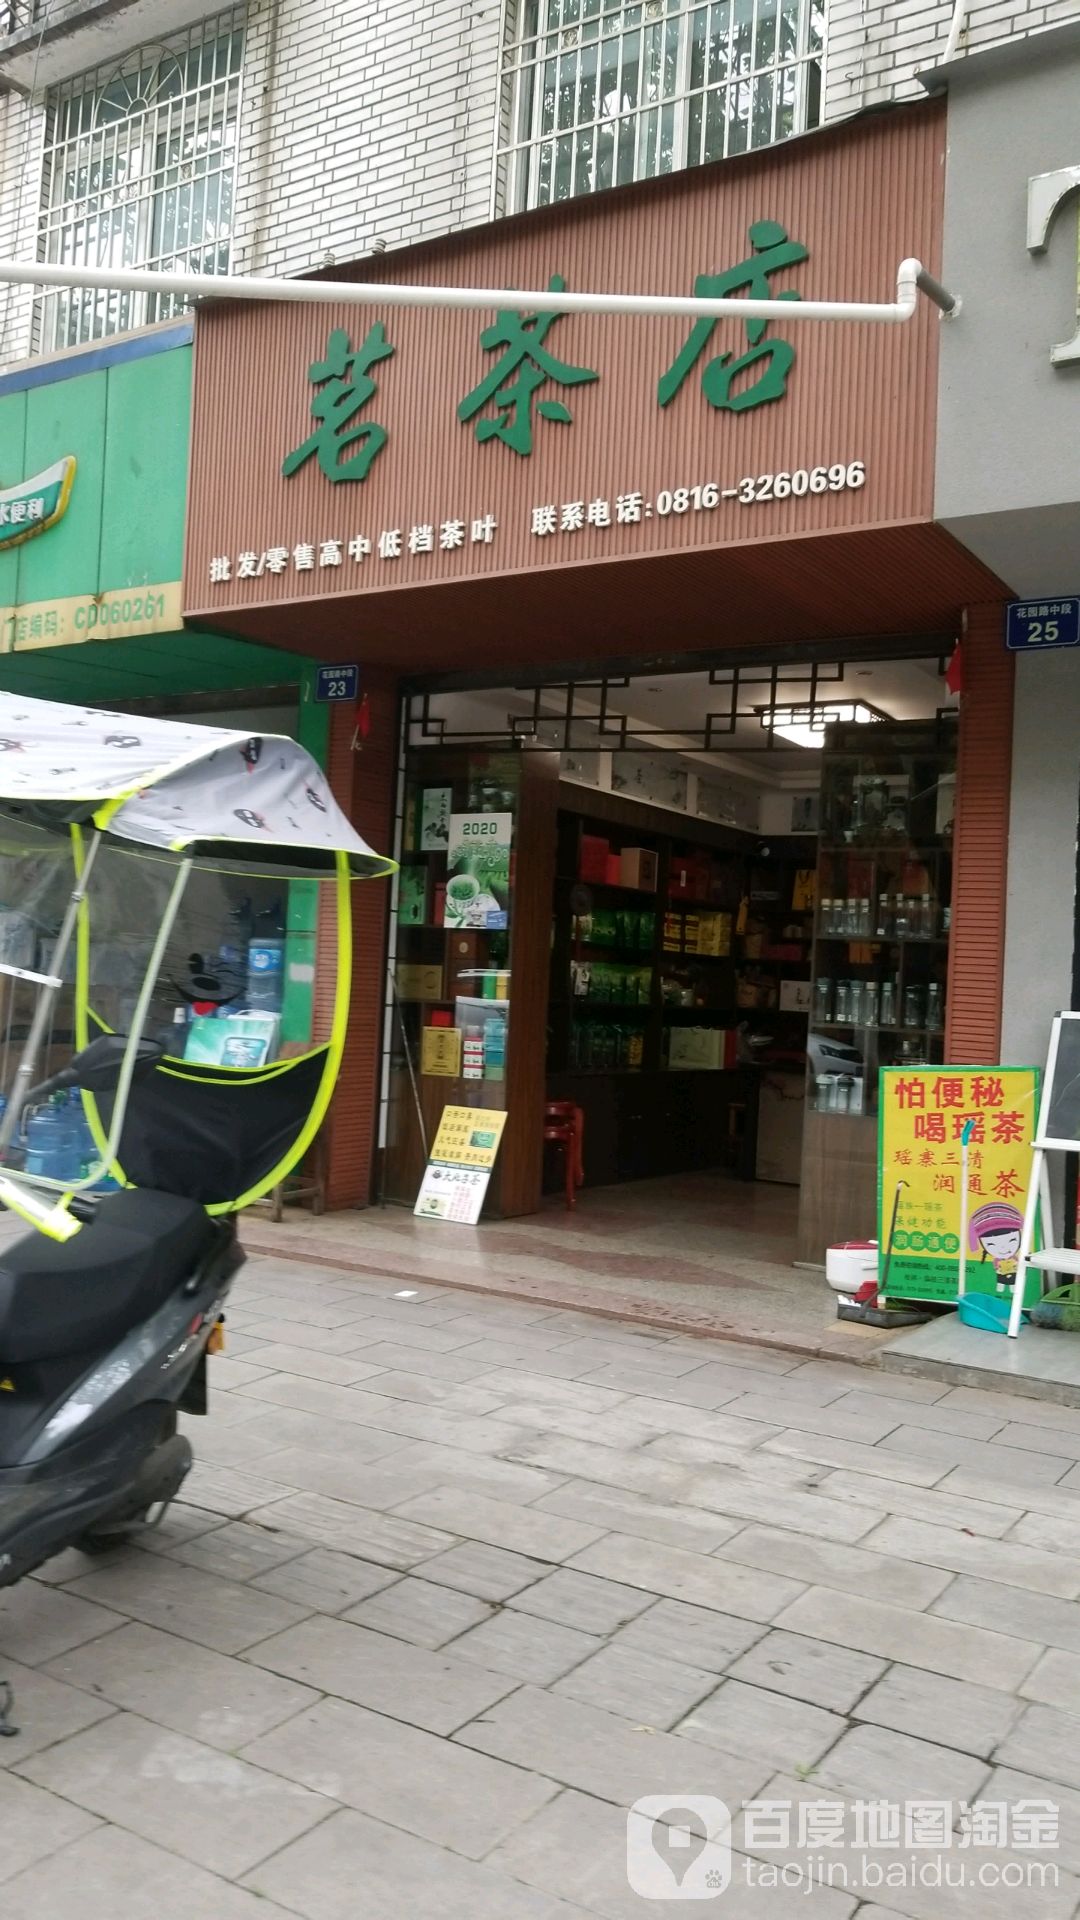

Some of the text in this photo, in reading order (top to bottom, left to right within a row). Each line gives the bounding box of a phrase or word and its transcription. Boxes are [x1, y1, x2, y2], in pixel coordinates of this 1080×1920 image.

[282, 219, 809, 484] 茗茶店
[209, 514, 498, 582] 批发/零售高中低档茶叶
[1016, 603, 1073, 619] 花园路中段
[1027, 620, 1059, 643] 25
[327, 681, 347, 697] 23
[462, 822, 498, 836] 2020
[893, 1075, 1006, 1109] 怕便秘
[913, 1111, 1026, 1145] 喝瑶茶
